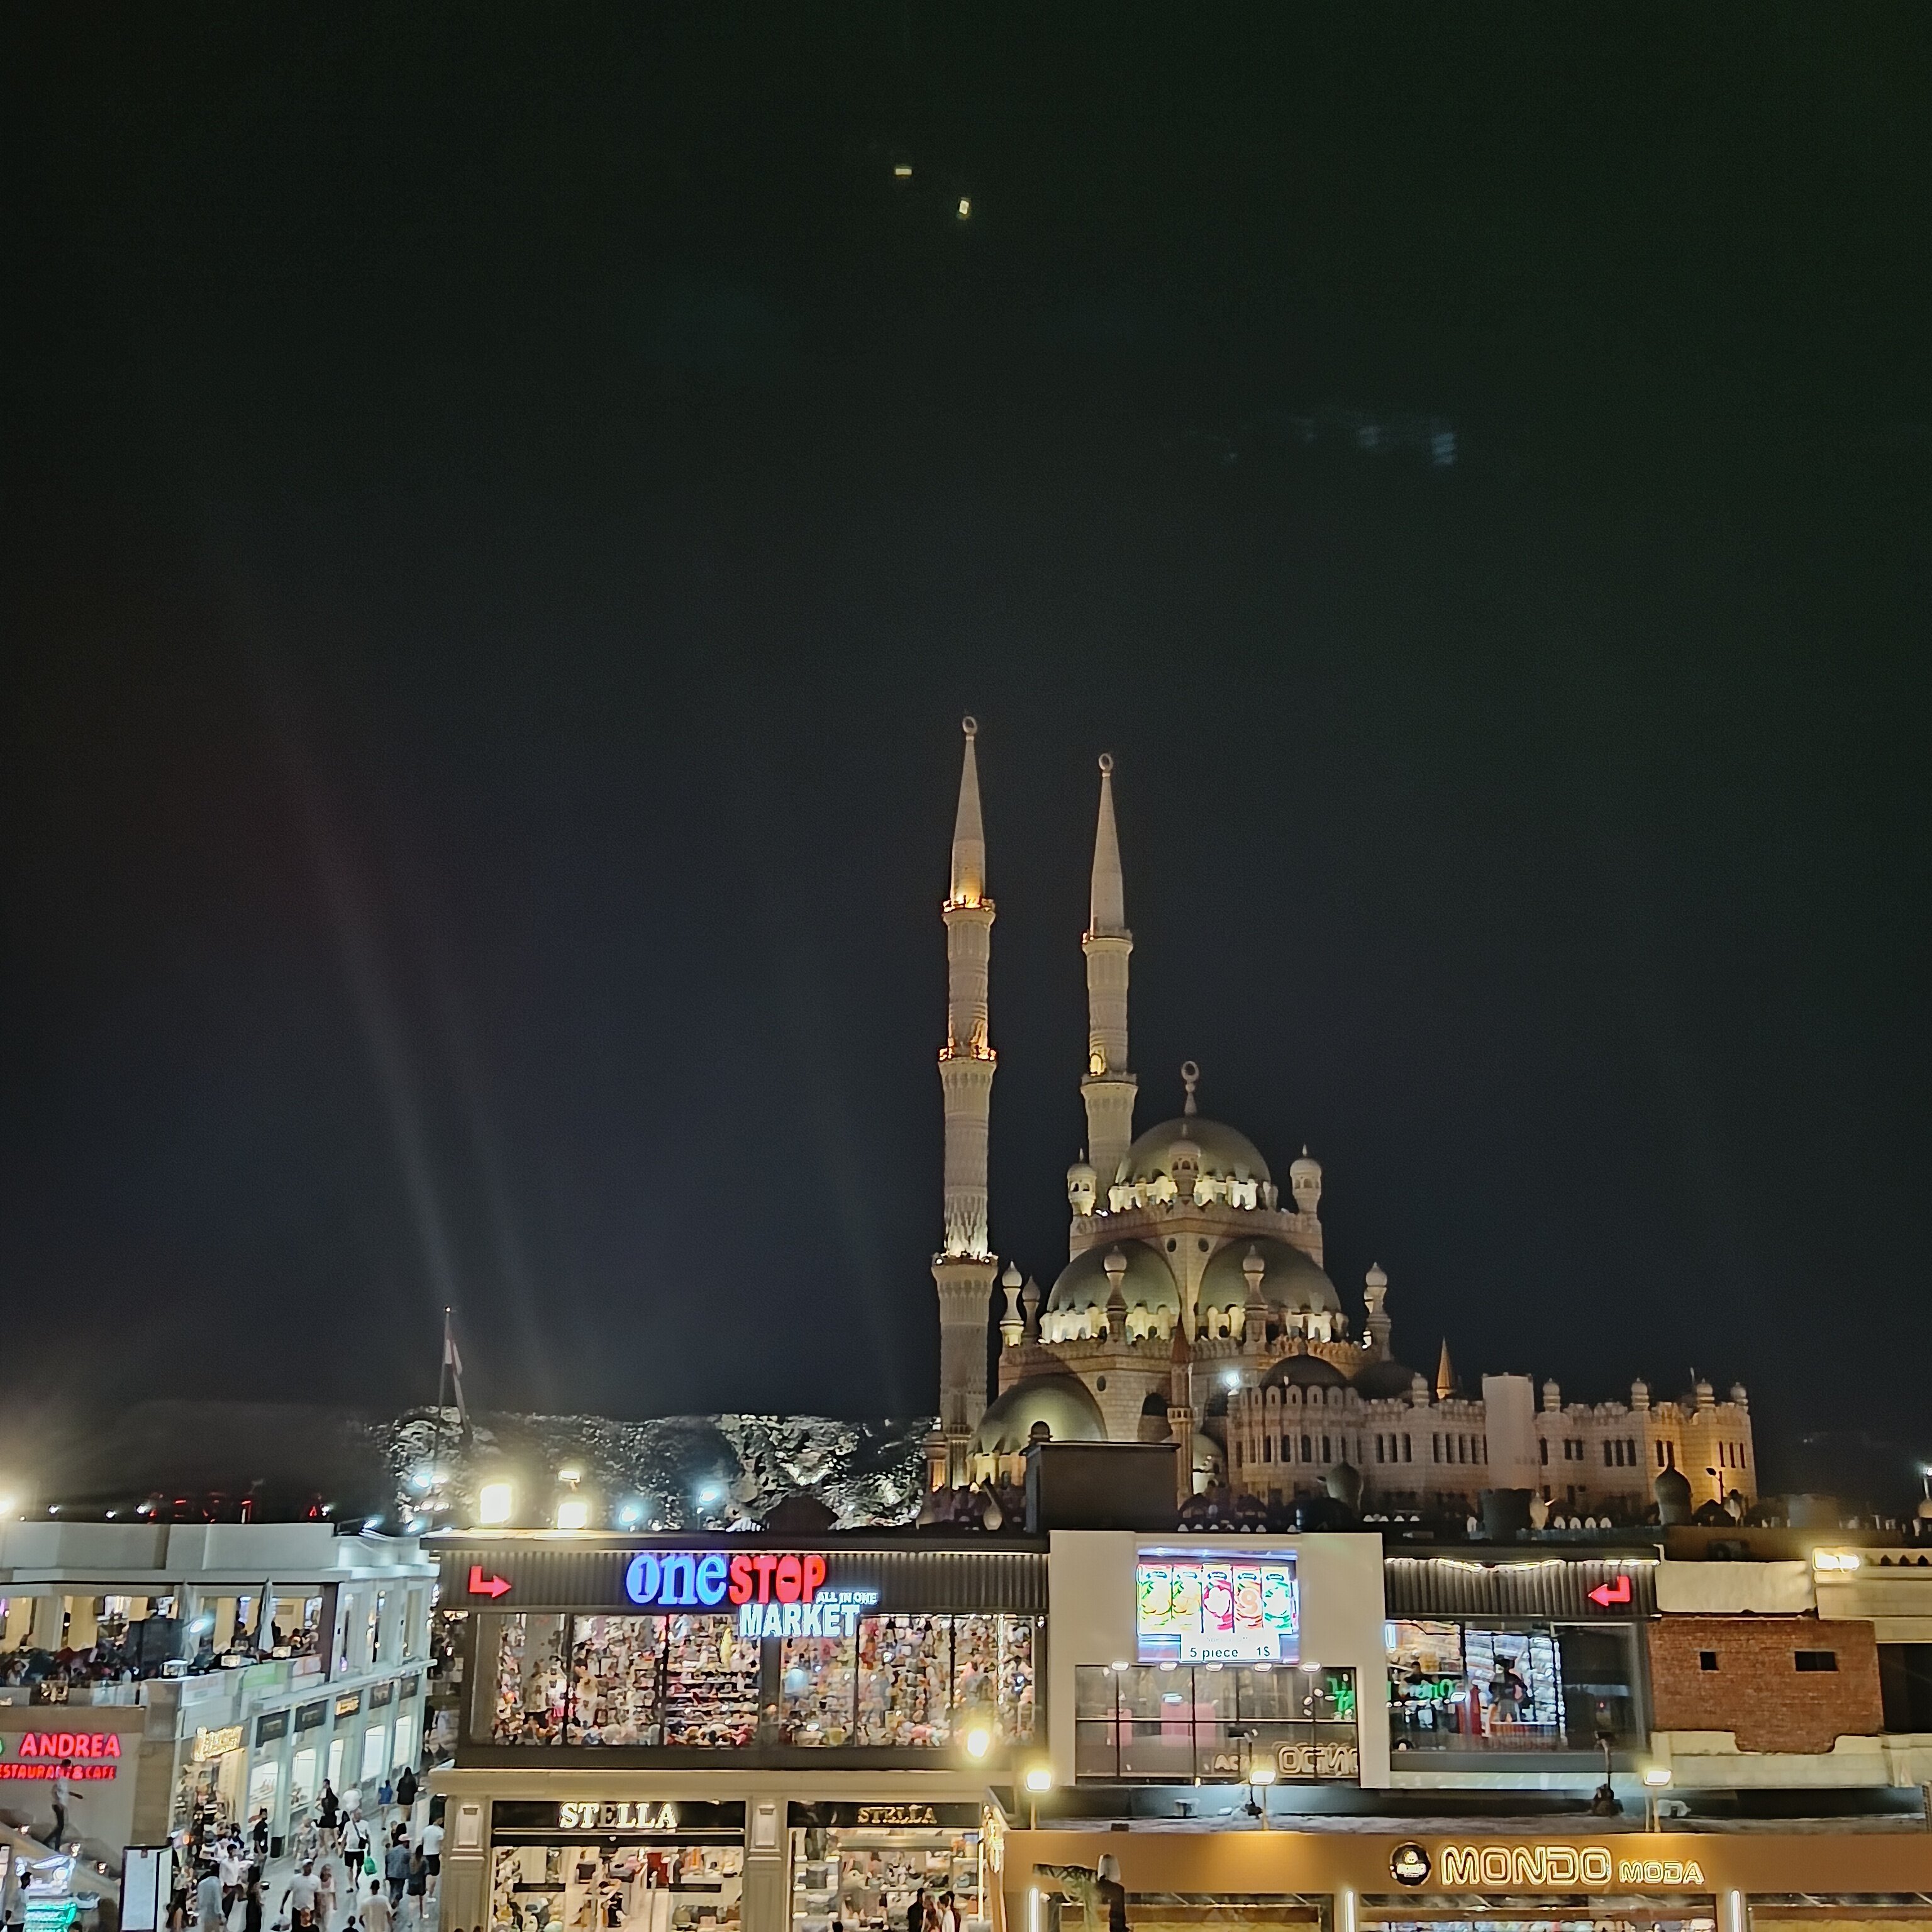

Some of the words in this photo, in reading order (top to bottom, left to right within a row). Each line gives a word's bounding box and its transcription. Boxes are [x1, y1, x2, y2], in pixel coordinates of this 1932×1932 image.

[728, 1554, 826, 1605] STOP
[816, 1591, 838, 1604] ALL
[838, 1592, 852, 1604] IN
[853, 1592, 878, 1604] ONE
[738, 1603, 861, 1637] MARKET
[1190, 1647, 1197, 1657] 5
[1202, 1649, 1238, 1660] piece
[19, 1733, 121, 1757] ANDREA
[72, 1765, 83, 1779] &
[85, 1766, 116, 1779] CAFE
[559, 1802, 677, 1828] STELLA
[857, 1804, 937, 1824] STELLA
[1441, 1846, 1611, 1885] MONDO
[1619, 1860, 1705, 1885] MODA
